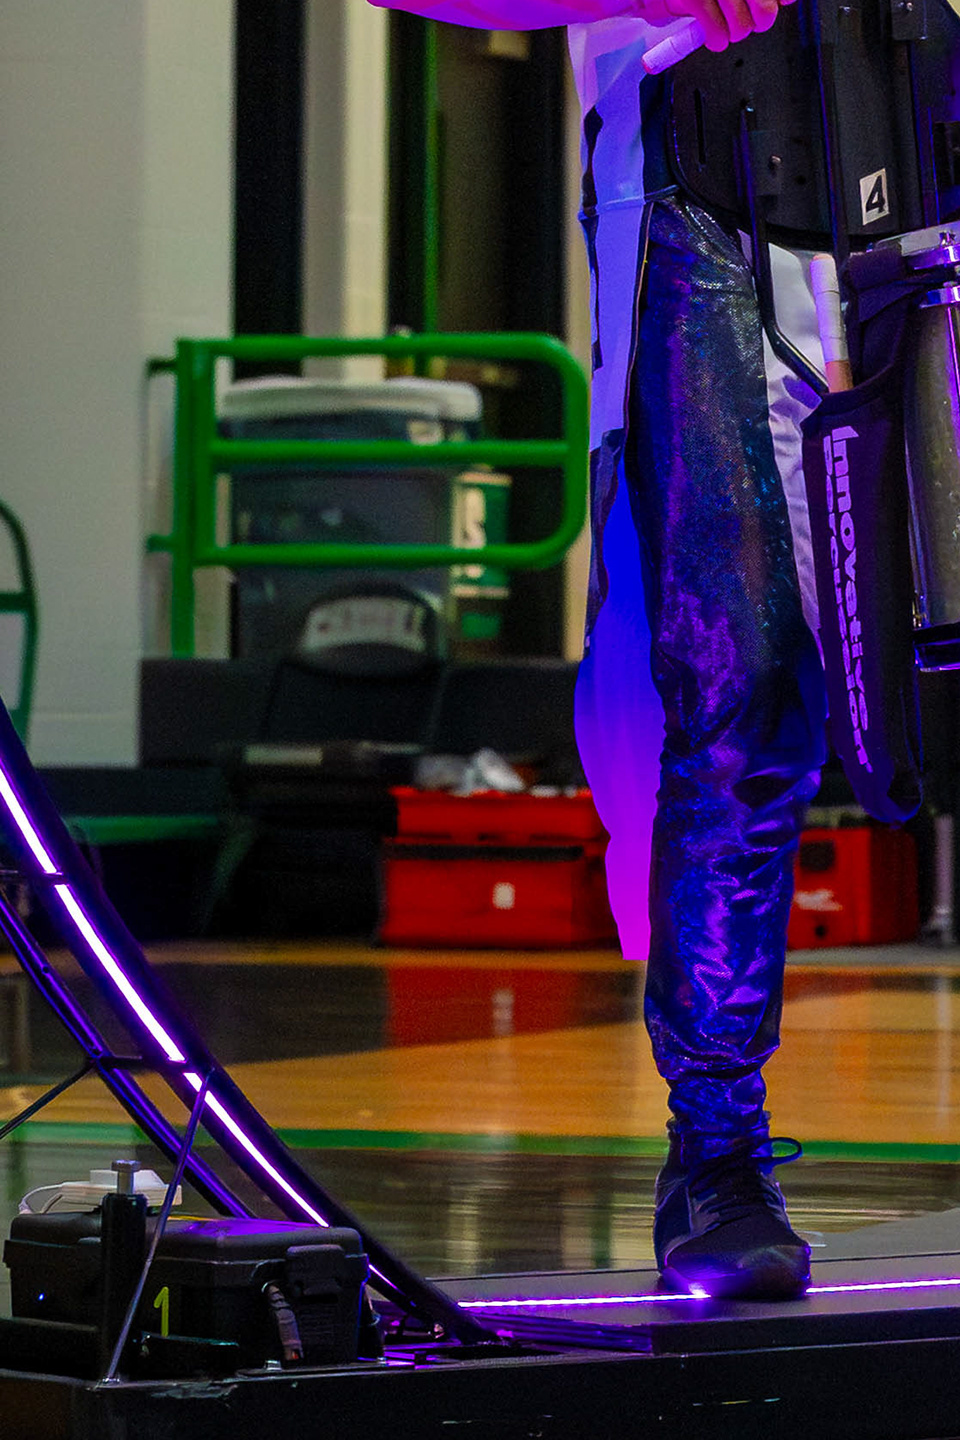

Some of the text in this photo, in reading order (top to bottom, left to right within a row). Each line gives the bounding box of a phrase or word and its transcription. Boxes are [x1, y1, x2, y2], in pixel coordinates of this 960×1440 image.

[865, 174, 886, 213] 4
[831, 425, 868, 731] Innovative
[153, 1285, 170, 1337] 1
